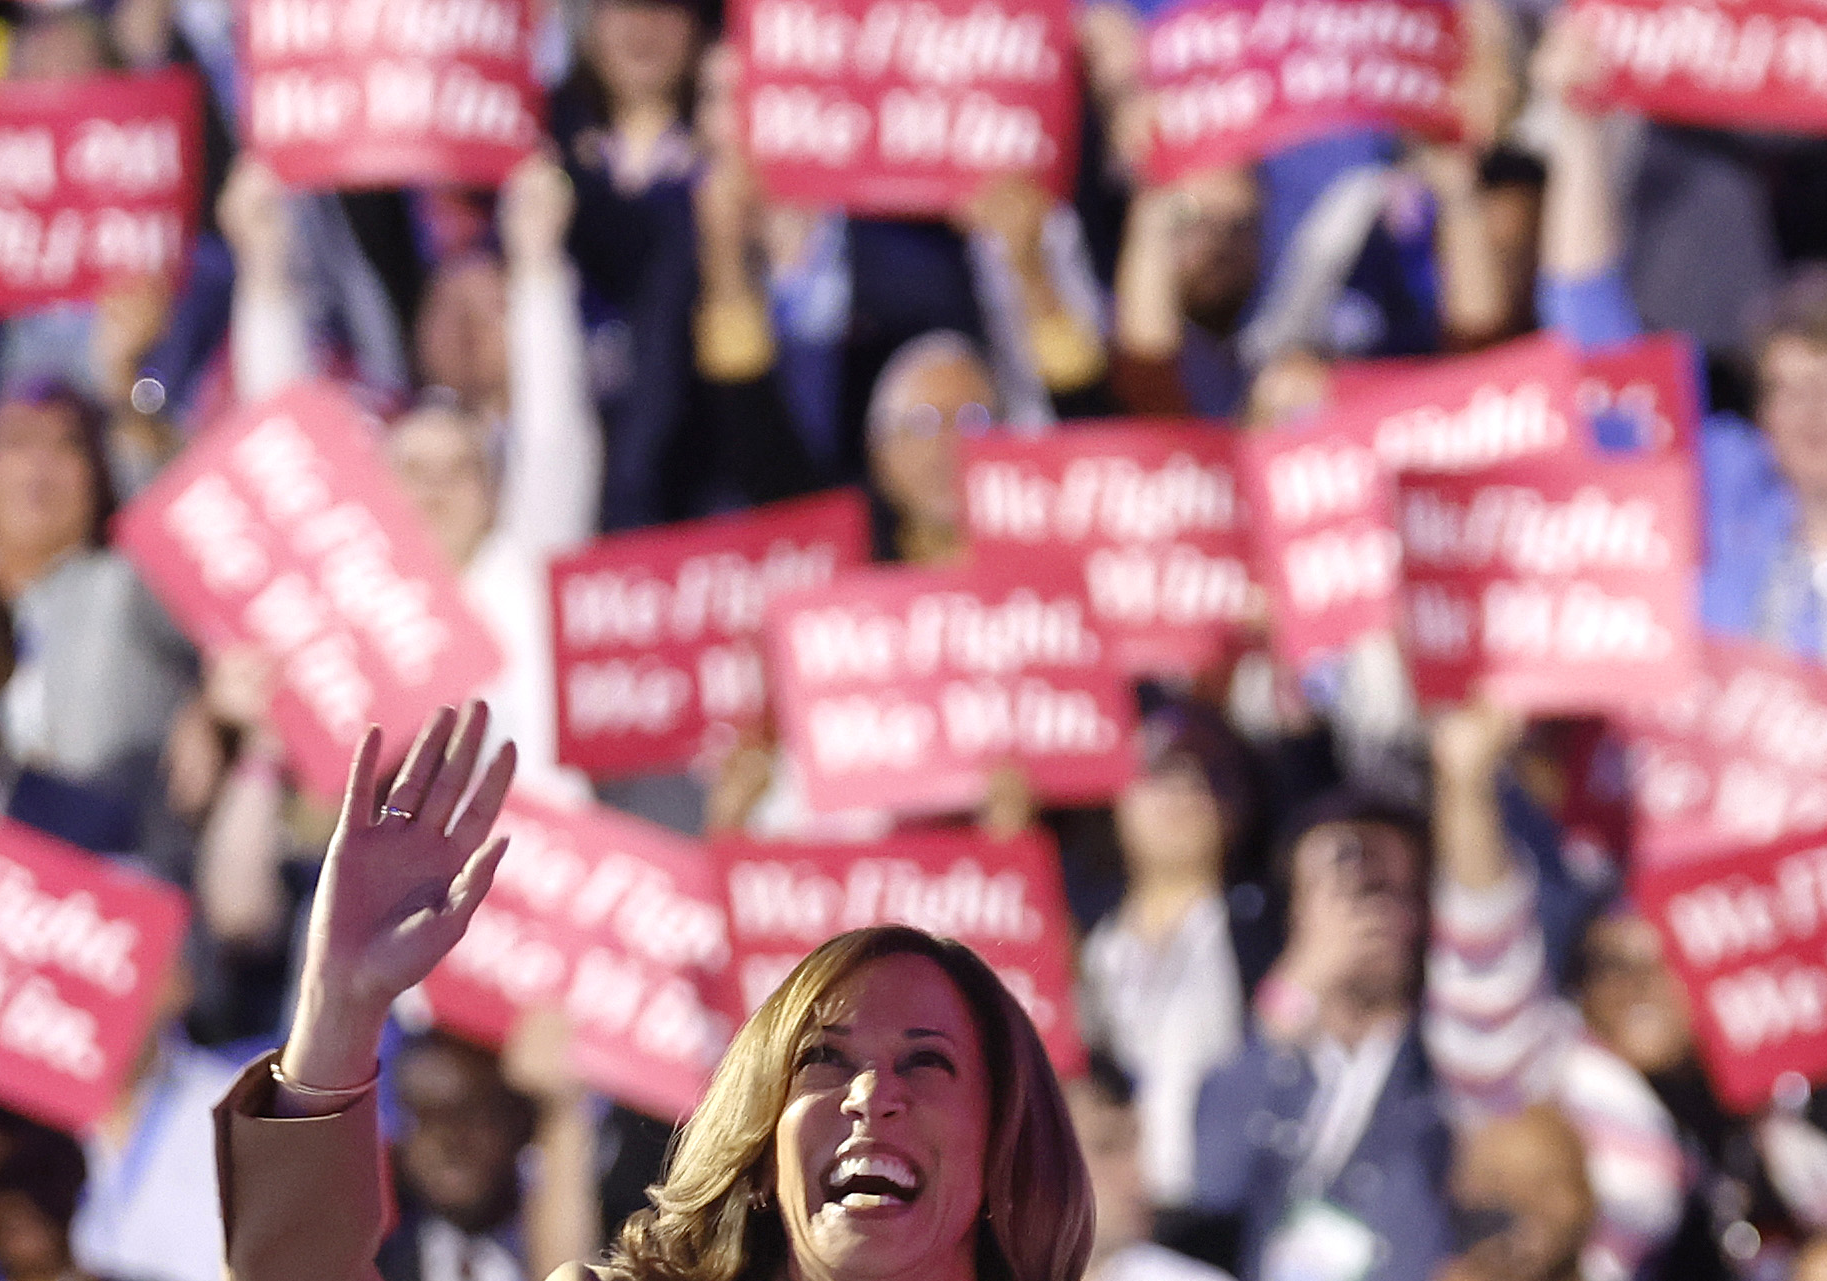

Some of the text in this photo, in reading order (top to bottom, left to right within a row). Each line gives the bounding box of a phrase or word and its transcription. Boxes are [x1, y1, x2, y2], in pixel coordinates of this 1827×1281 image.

[750, 6, 1057, 85] We Fight.
[252, 60, 541, 144] We Win.
[751, 86, 1057, 164] We Win.
[232, 413, 333, 517] We
[165, 471, 271, 593] We
[1463, 484, 1673, 577] Fight.
[562, 566, 663, 644] We
[789, 588, 1101, 680] We Fight.
[1481, 580, 1675, 664] Win.
[569, 655, 694, 735] We
[808, 682, 1118, 770] We Win.
[727, 857, 841, 940] We
[1666, 872, 1778, 970] We
